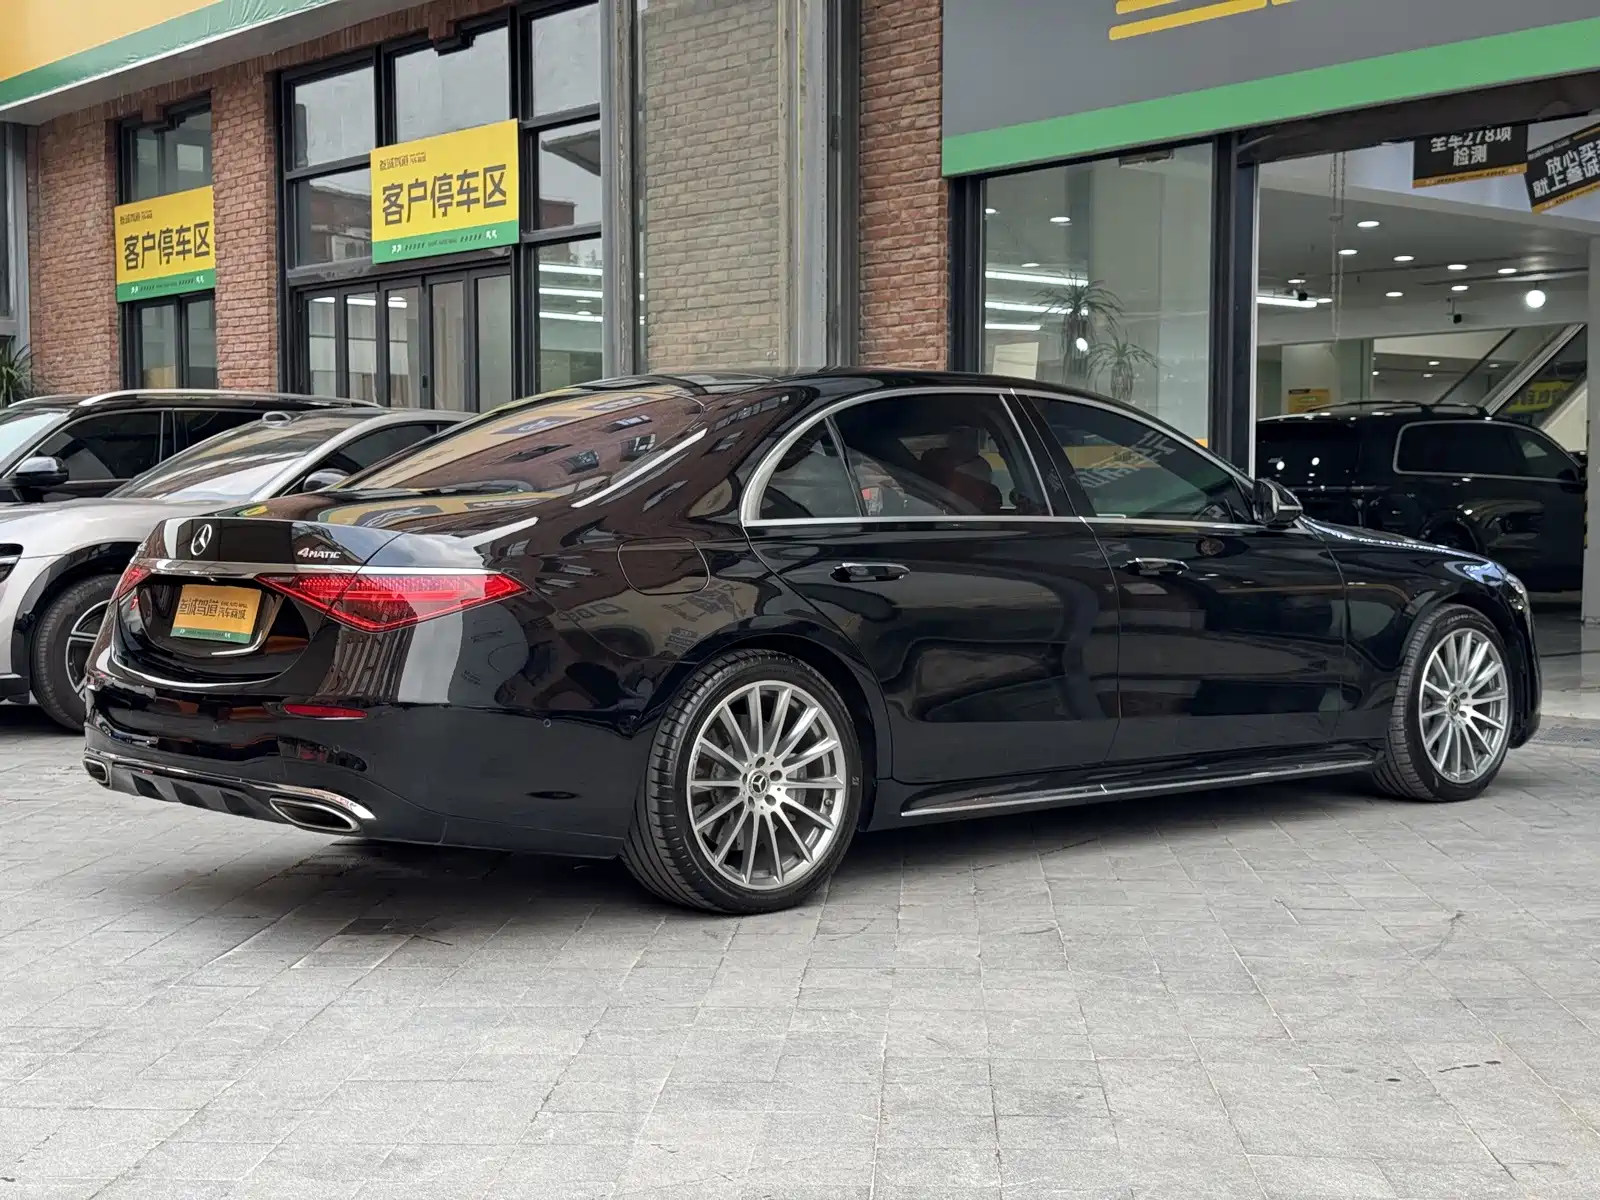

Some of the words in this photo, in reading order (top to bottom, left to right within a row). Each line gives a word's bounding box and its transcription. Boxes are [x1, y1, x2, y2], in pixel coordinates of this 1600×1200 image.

[1453, 144, 1488, 167] 检测
[1545, 139, 1600, 177] 放心买
[382, 163, 507, 226] 客户停车区
[124, 221, 211, 271] 客户停车区
[297, 547, 342, 559] 4MATIC
